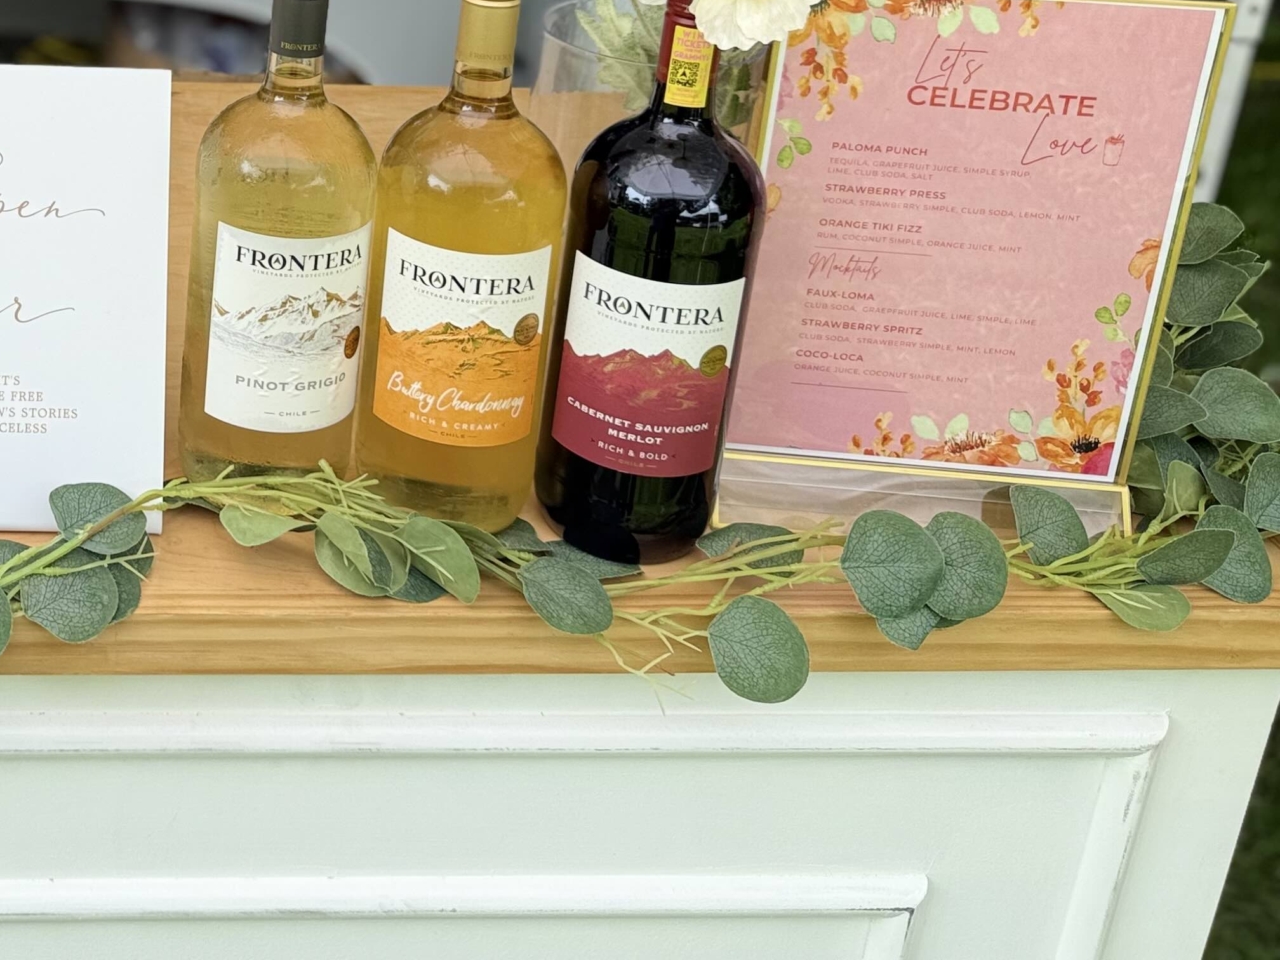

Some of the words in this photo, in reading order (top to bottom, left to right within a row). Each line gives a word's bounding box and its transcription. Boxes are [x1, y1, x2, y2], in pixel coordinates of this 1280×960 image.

[915, 35, 988, 89] Let's
[907, 85, 1097, 118] CELEBRATE
[1021, 113, 1098, 165] Love
[832, 142, 882, 152] PALOMA
[886, 146, 928, 156] PUNCH
[854, 169, 878, 177] CLUB
[873, 161, 930, 171] GRAPEFRUIT
[963, 167, 997, 176] SIMPLE
[825, 184, 906, 196] STRAWBERRY
[910, 190, 946, 200] PRESS
[860, 200, 920, 210] STRAWBERRY
[961, 207, 985, 215] CLUB
[819, 218, 868, 229] ORANGE
[873, 222, 893, 231] TIKI
[897, 224, 922, 233] FIZZ
[842, 234, 887, 243] COCONUT
[927, 240, 966, 249] ORANGE
[236, 244, 362, 272] FRONTERA
[808, 252, 882, 282] Mocktails
[399, 259, 535, 296] FRONTERA
[807, 288, 875, 301] FAUX-LOMA
[583, 281, 724, 326] FRONTERA
[801, 319, 880, 332] STRAWBERRY
[883, 325, 922, 335] SPRITZ
[798, 332, 822, 340] CLUB
[857, 338, 917, 348] STRAWBERRY
[984, 348, 1016, 356] LEMON
[796, 350, 863, 361] COCO-LOCA
[794, 363, 830, 372] ORANGE
[863, 369, 907, 378] COCONUT
[236, 375, 289, 391] PINOT
[295, 372, 345, 391] GRIGIO
[11, 391, 44, 402] FREE
[387, 370, 435, 413] Buttery
[436, 387, 525, 418] Chardonnay
[21, 407, 78, 419] STORIES
[409, 411, 435, 425] RICH
[454, 423, 499, 431] CREAMY
[567, 396, 632, 428] CABERNET
[635, 422, 709, 434] SAUVIGNON
[440, 431, 465, 439] CHILE
[608, 428, 663, 445] MERLOT
[598, 440, 624, 454] RICH
[628, 449, 635, 457] &
[639, 451, 668, 461] BOLD
